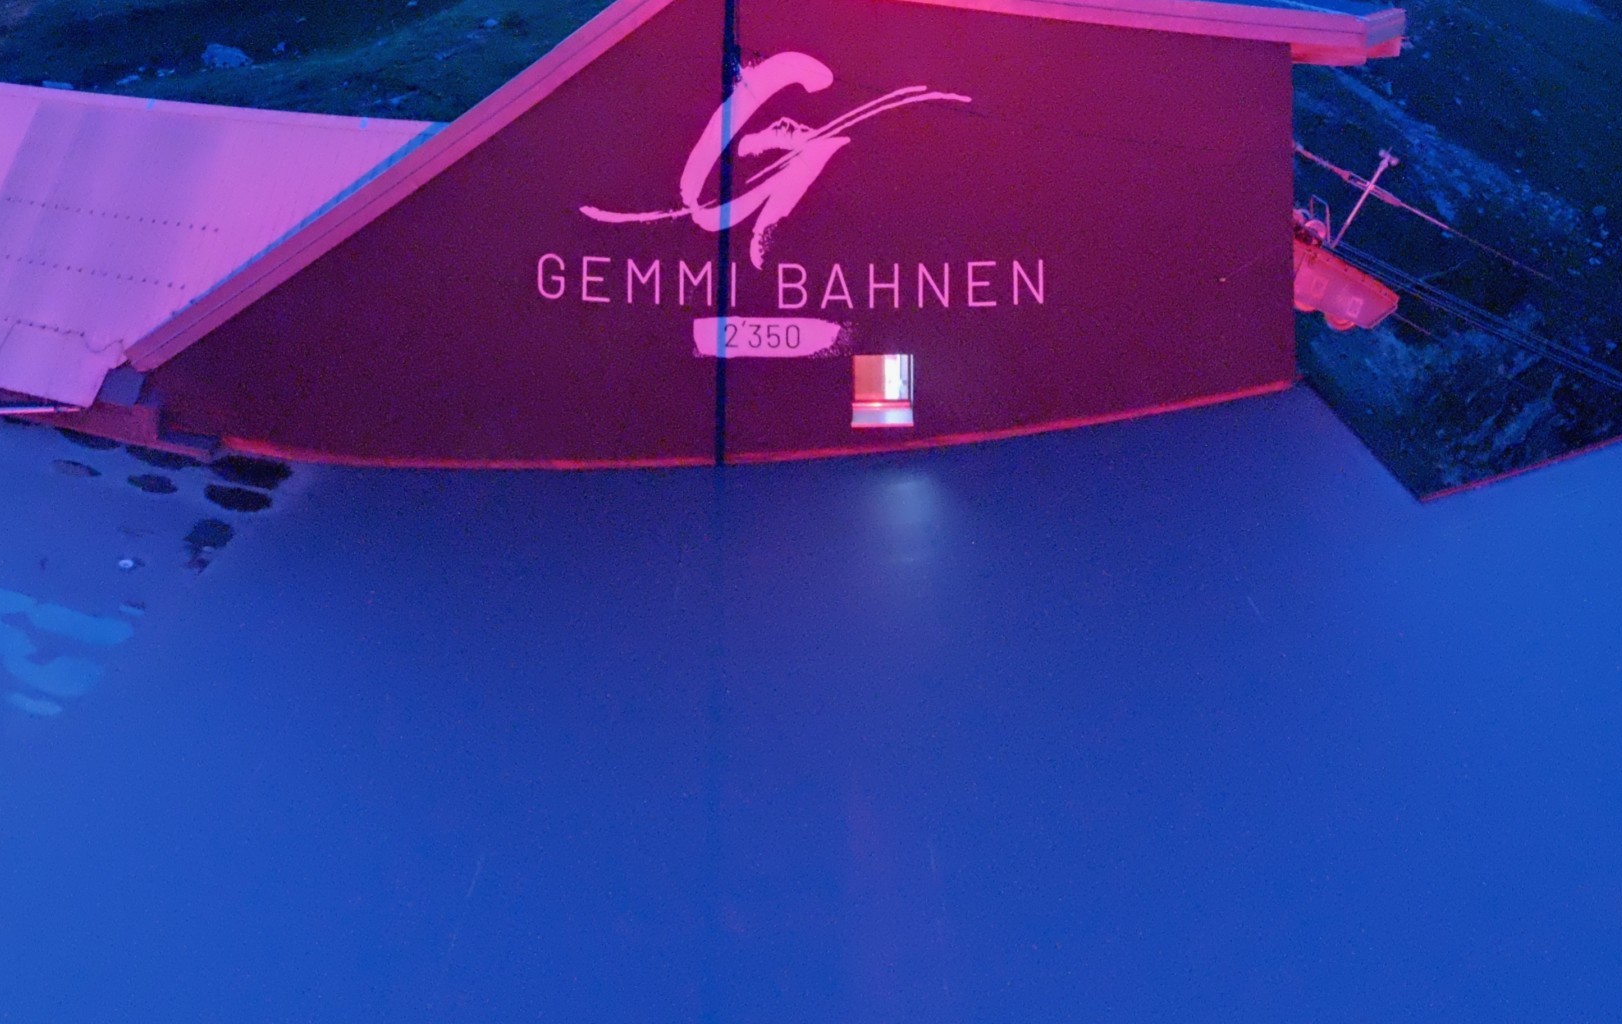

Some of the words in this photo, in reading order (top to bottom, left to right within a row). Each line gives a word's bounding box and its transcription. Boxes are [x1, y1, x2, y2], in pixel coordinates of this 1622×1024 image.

[537, 253, 736, 306] GEMMI
[777, 259, 1045, 309] BAHNEN
[724, 320, 800, 349] 2'350
